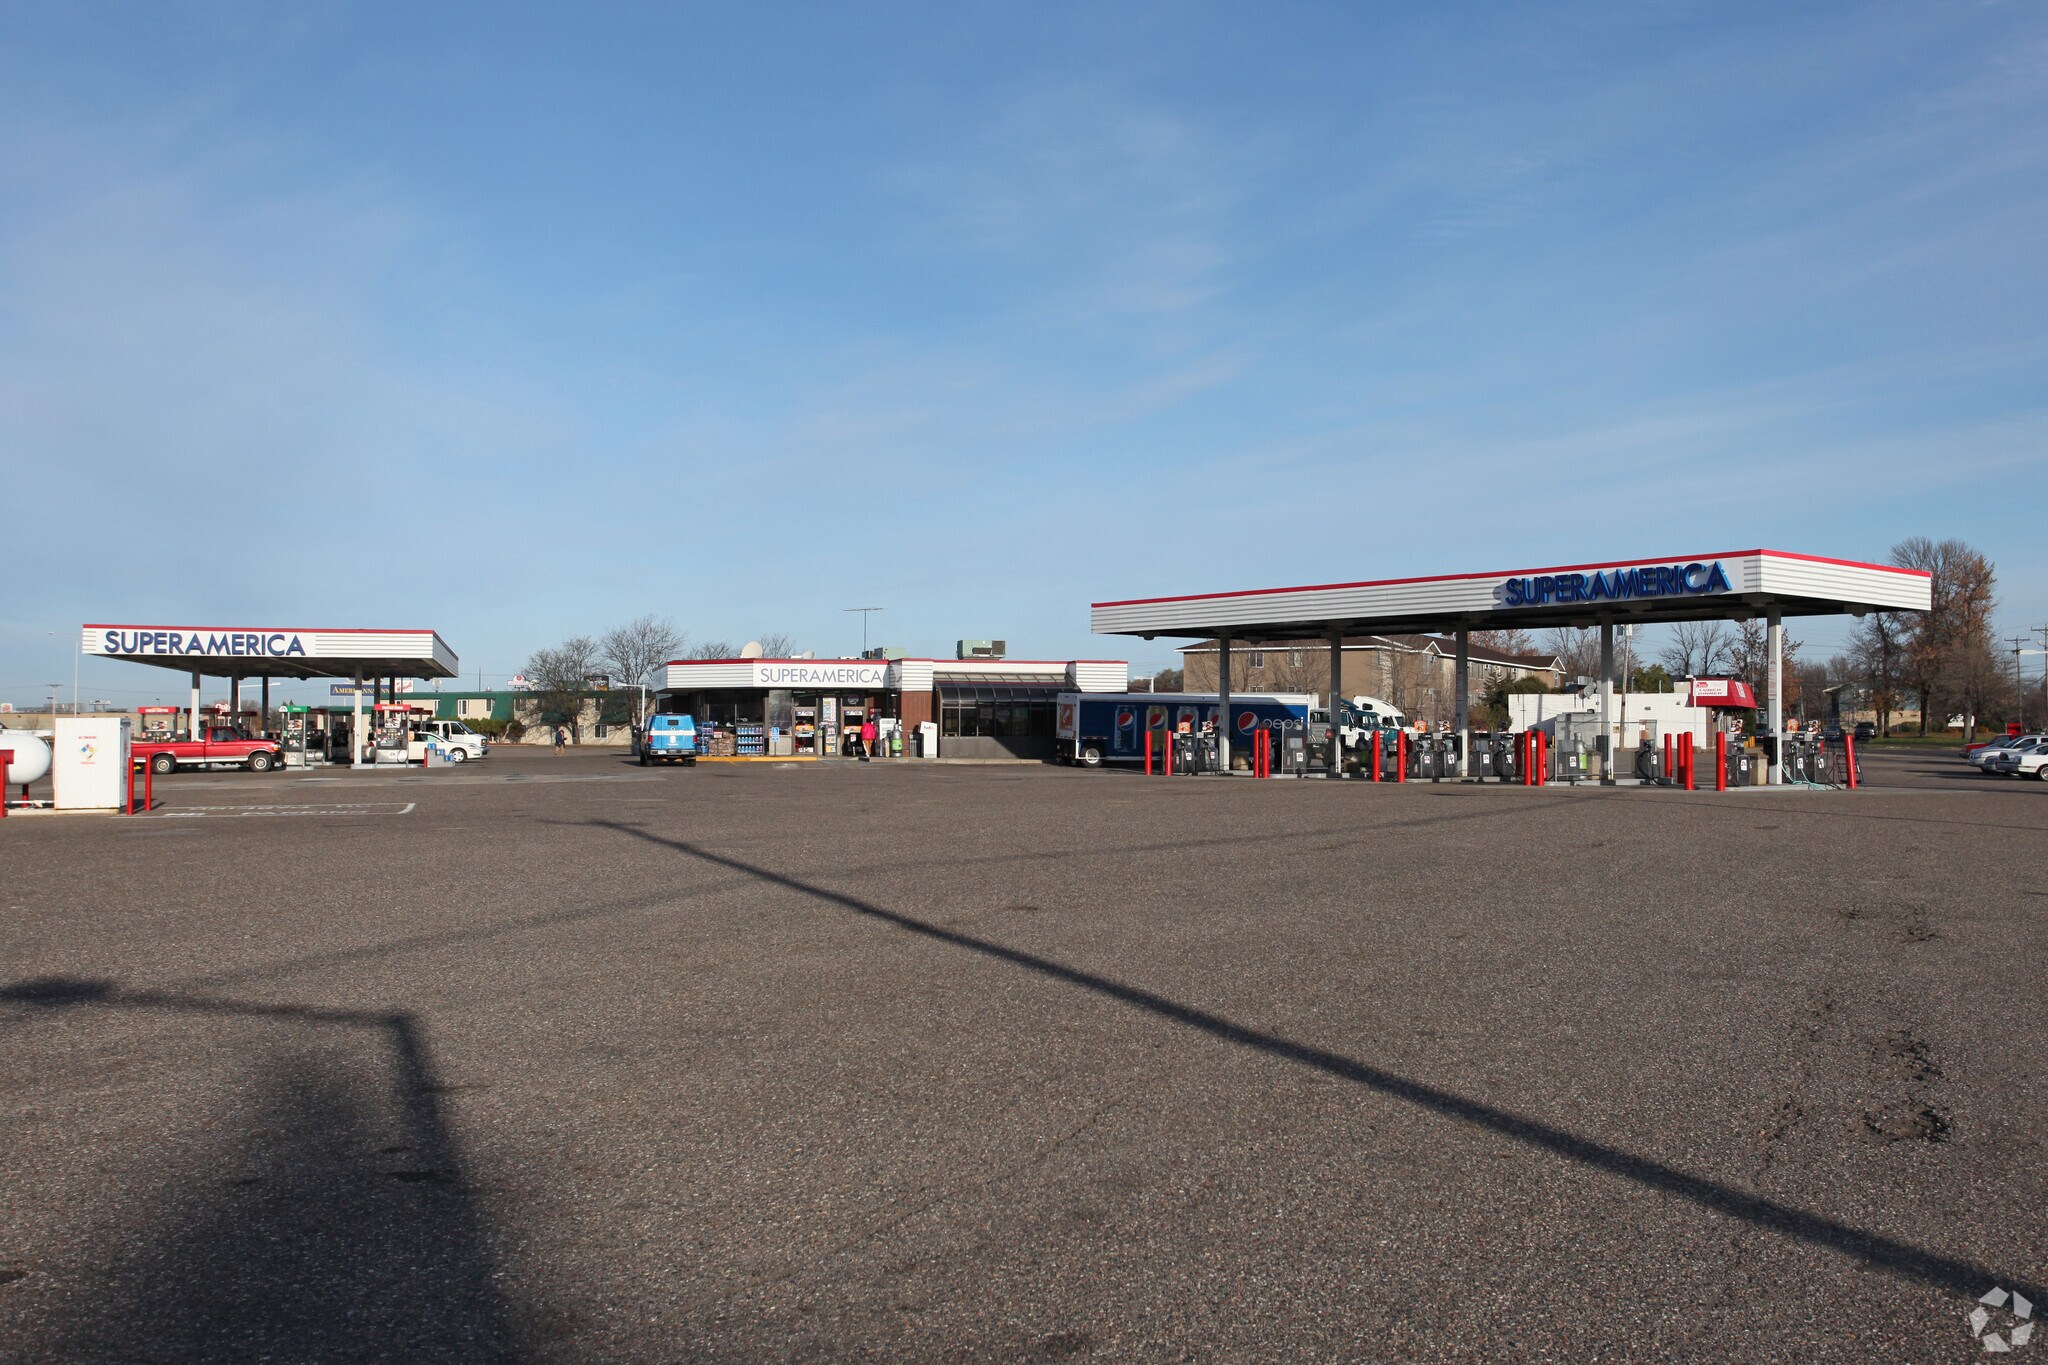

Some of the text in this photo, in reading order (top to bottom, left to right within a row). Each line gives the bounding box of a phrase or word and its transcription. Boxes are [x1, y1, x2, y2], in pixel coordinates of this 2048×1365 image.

[1505, 561, 1733, 606] SUPERAMERICA
[104, 630, 306, 656] SUPERAMERICA
[760, 668, 883, 683] SUPERAMERICA
